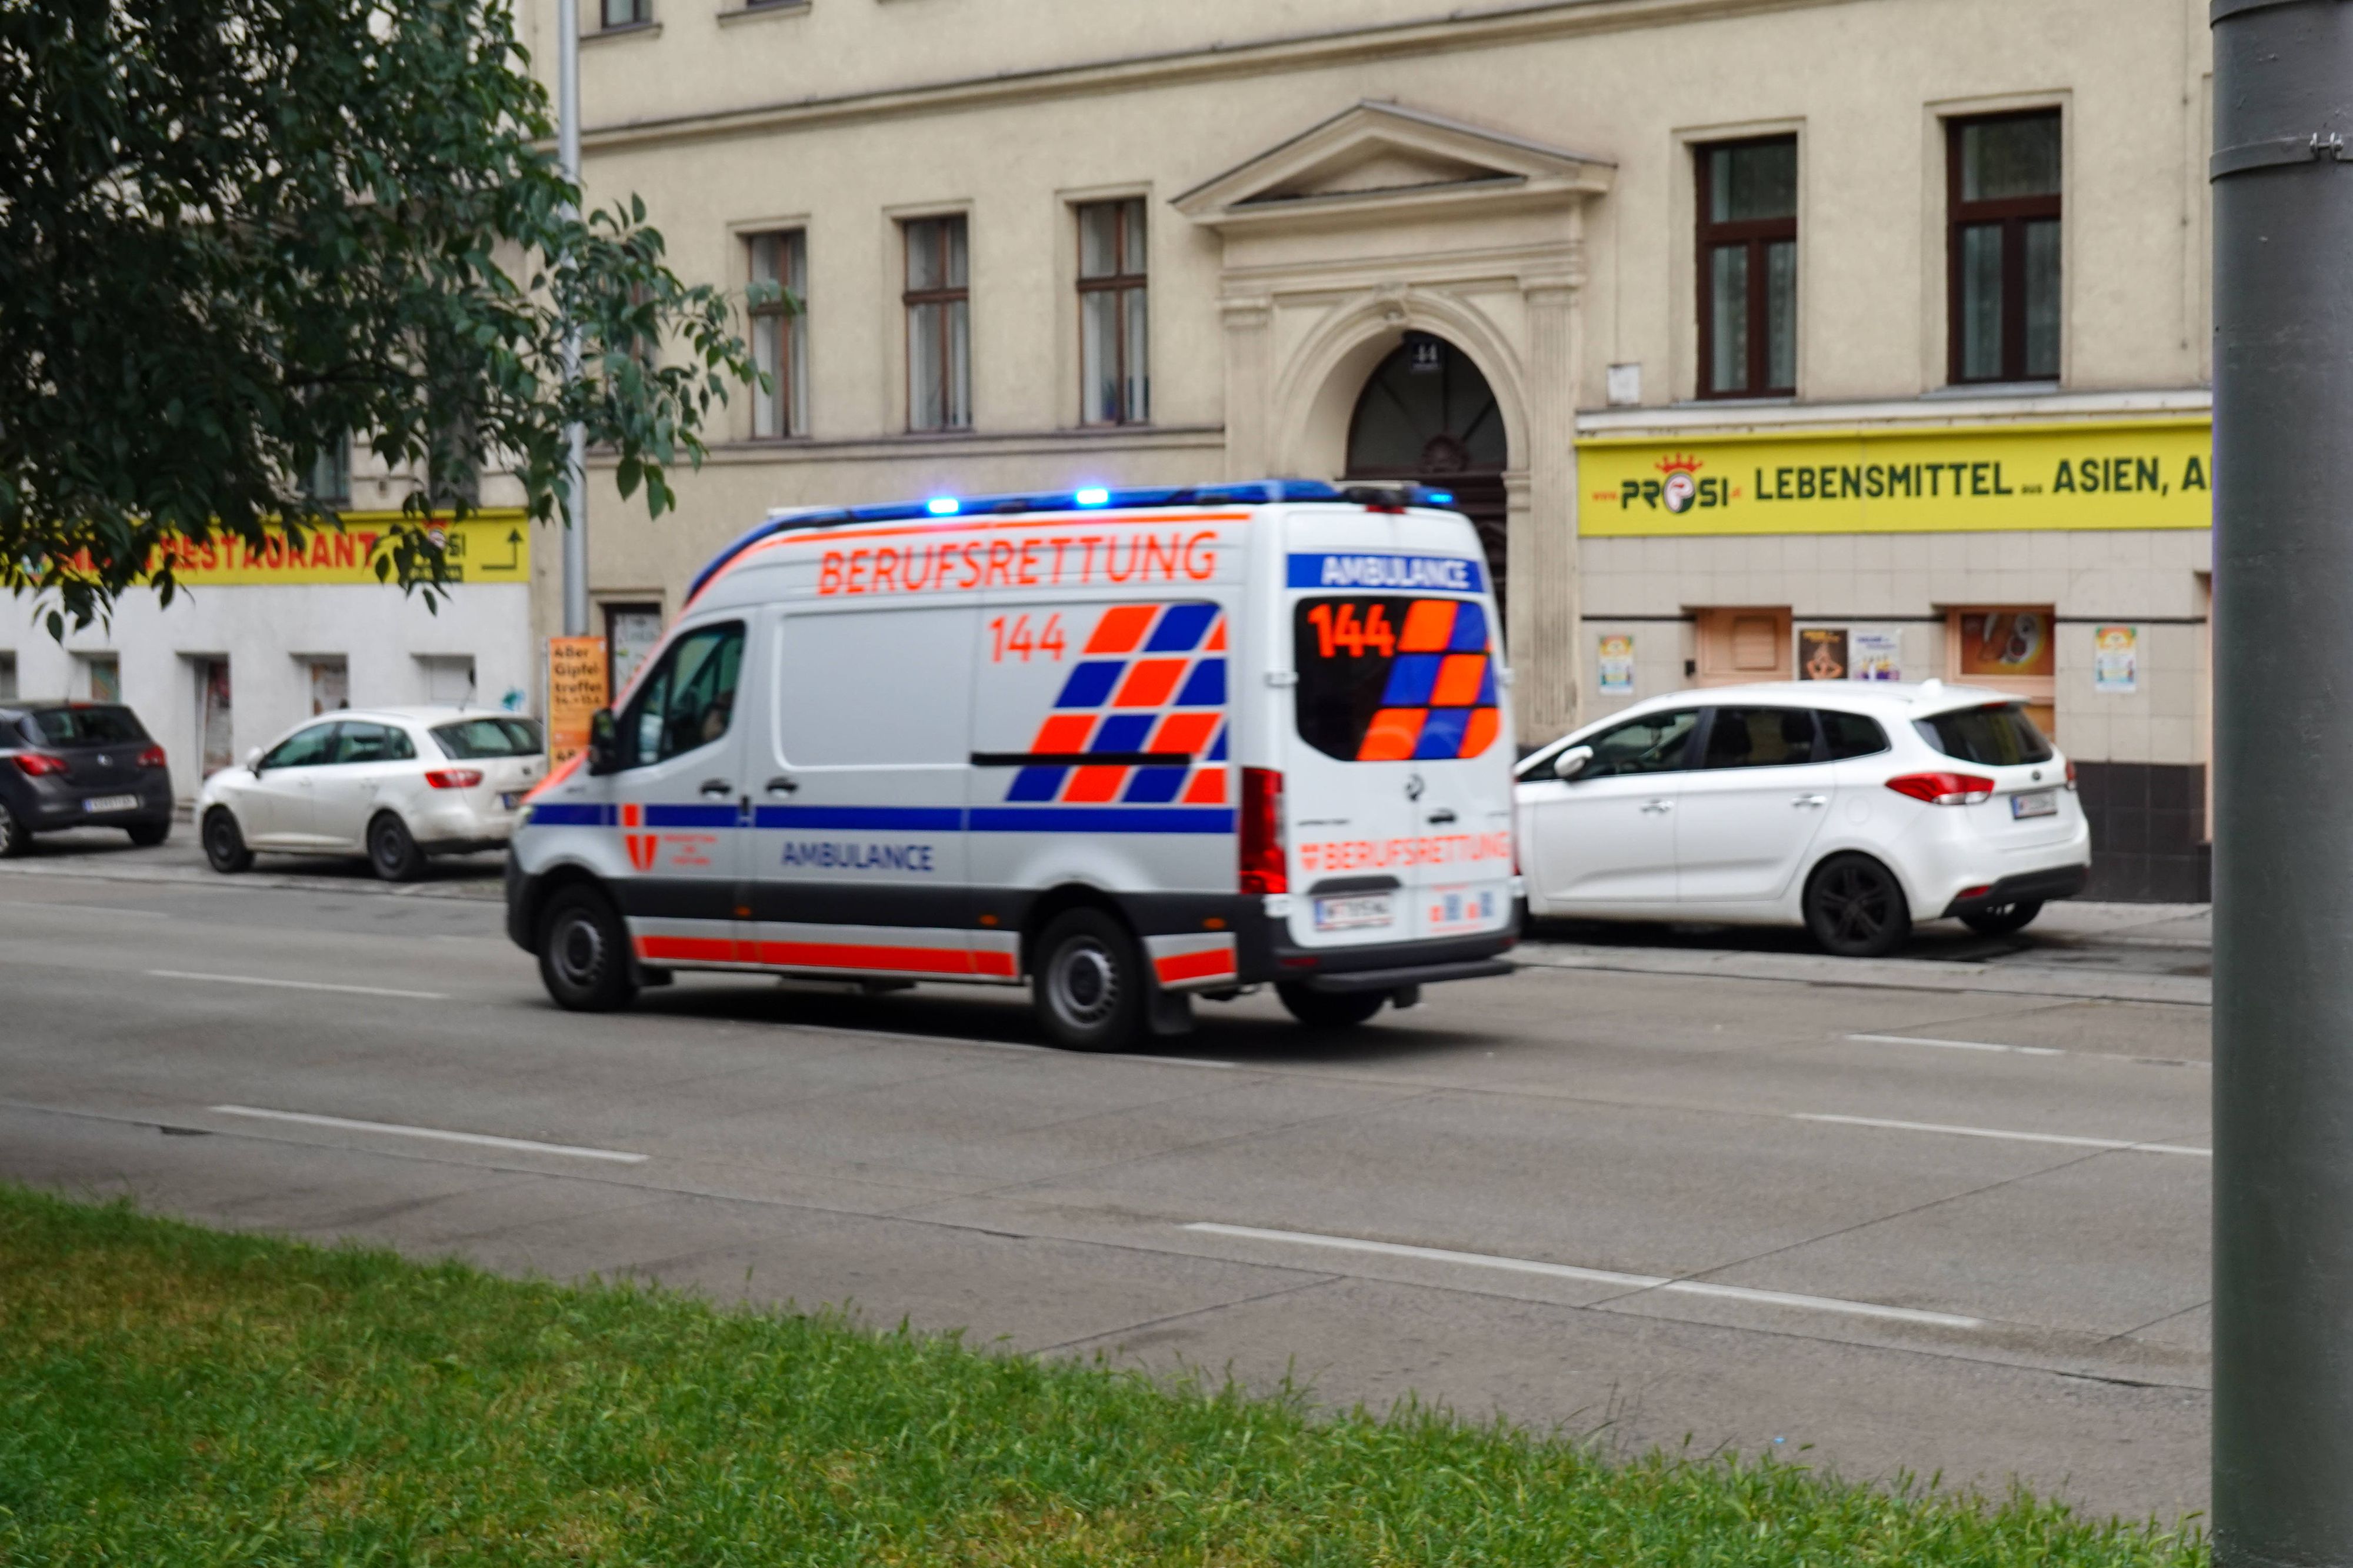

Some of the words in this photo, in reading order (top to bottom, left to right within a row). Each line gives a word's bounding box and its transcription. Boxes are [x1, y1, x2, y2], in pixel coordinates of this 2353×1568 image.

[1754, 461, 2013, 501] LEBENSMITTEL
[2052, 456, 2168, 497] ASIEN,
[2181, 453, 2212, 491] A
[818, 531, 1219, 595] BERUFSRETTUNG
[1320, 555, 1469, 588] AMBULANCE
[988, 613, 1067, 663] 144
[1307, 603, 1395, 658] 144
[781, 841, 934, 871] AMBULANCE
[1324, 830, 1511, 870] BERUFSRETTUNG
